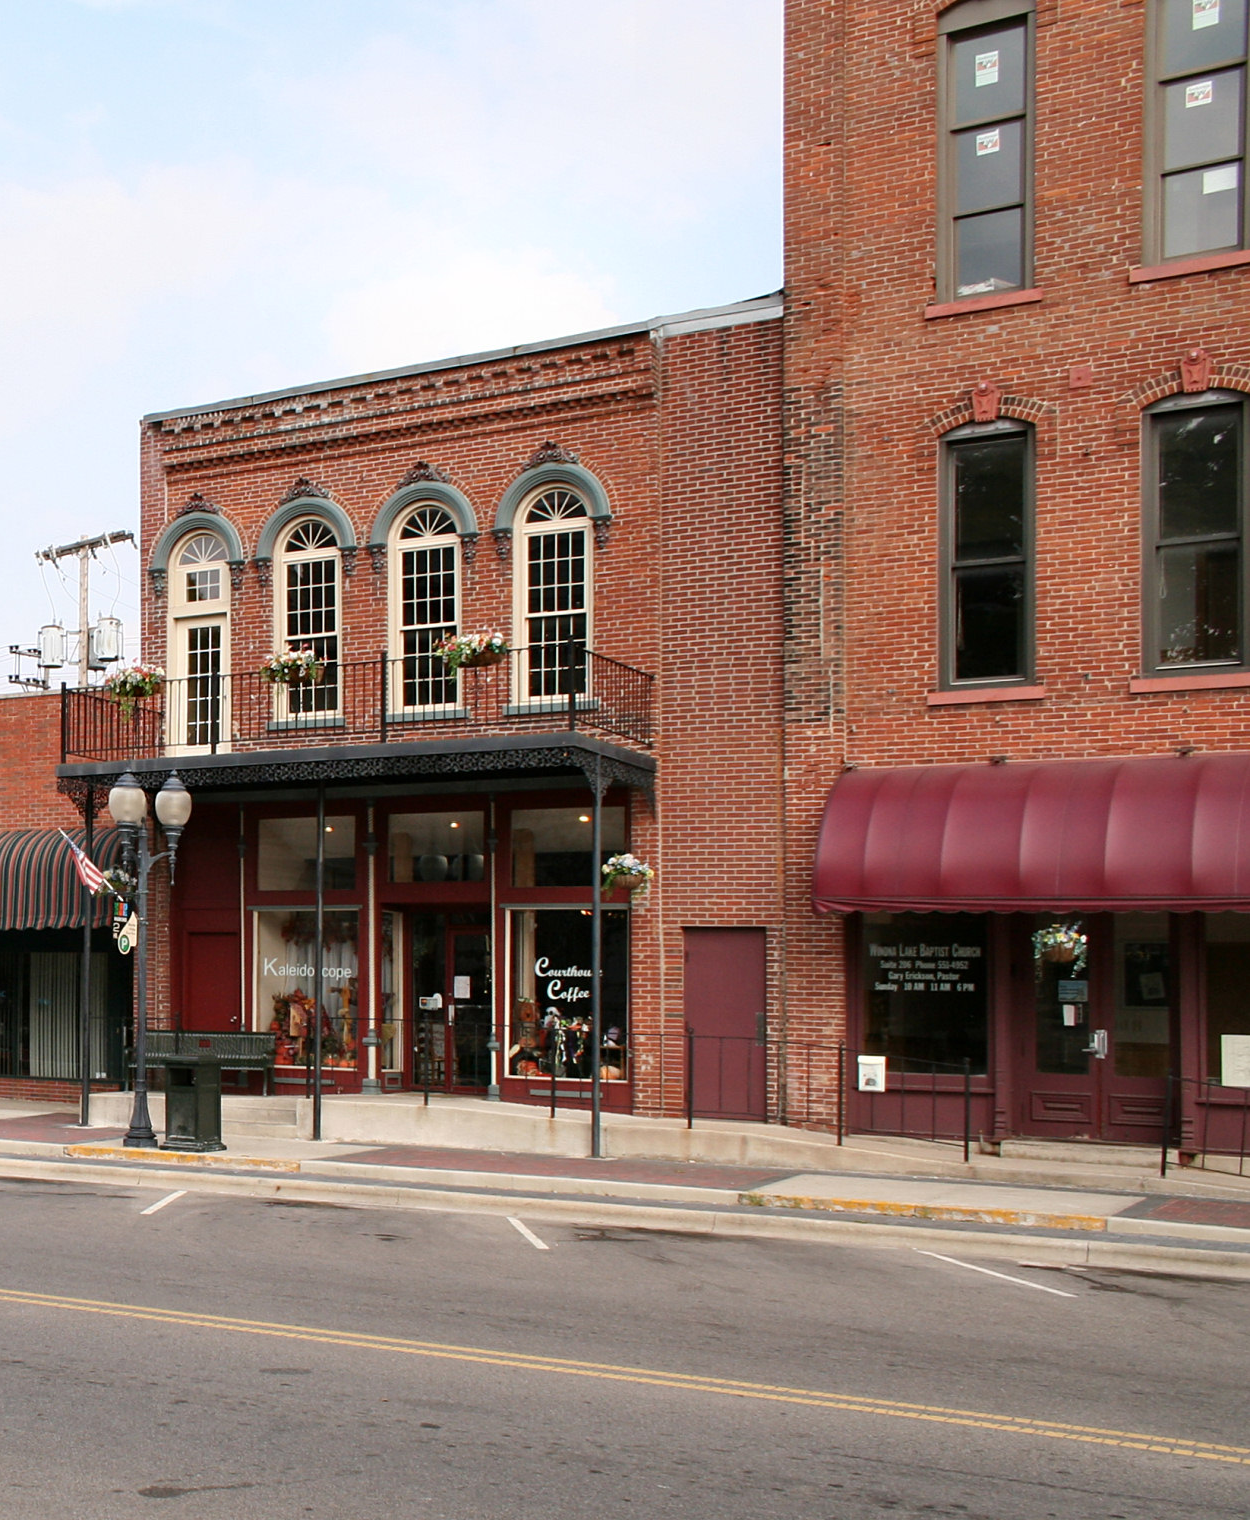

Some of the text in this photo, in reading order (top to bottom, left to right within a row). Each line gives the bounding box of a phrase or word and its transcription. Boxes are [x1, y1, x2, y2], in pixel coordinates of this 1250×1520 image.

[121, 937, 128, 951] P
[899, 944, 918, 957] LAKE
[919, 944, 950, 957] BAPTIST
[952, 943, 981, 957] CHURCH
[264, 957, 352, 981] Kaleidocope
[914, 960, 936, 969] Phone
[888, 971, 903, 981] Gary
[937, 971, 960, 980] Pastor
[546, 979, 589, 1002] Coffee
[874, 982, 898, 992] Sunday
[913, 982, 925, 991] AM
[939, 983, 951, 991] AM
[956, 983, 962, 991] 6
[963, 983, 975, 991] PM
